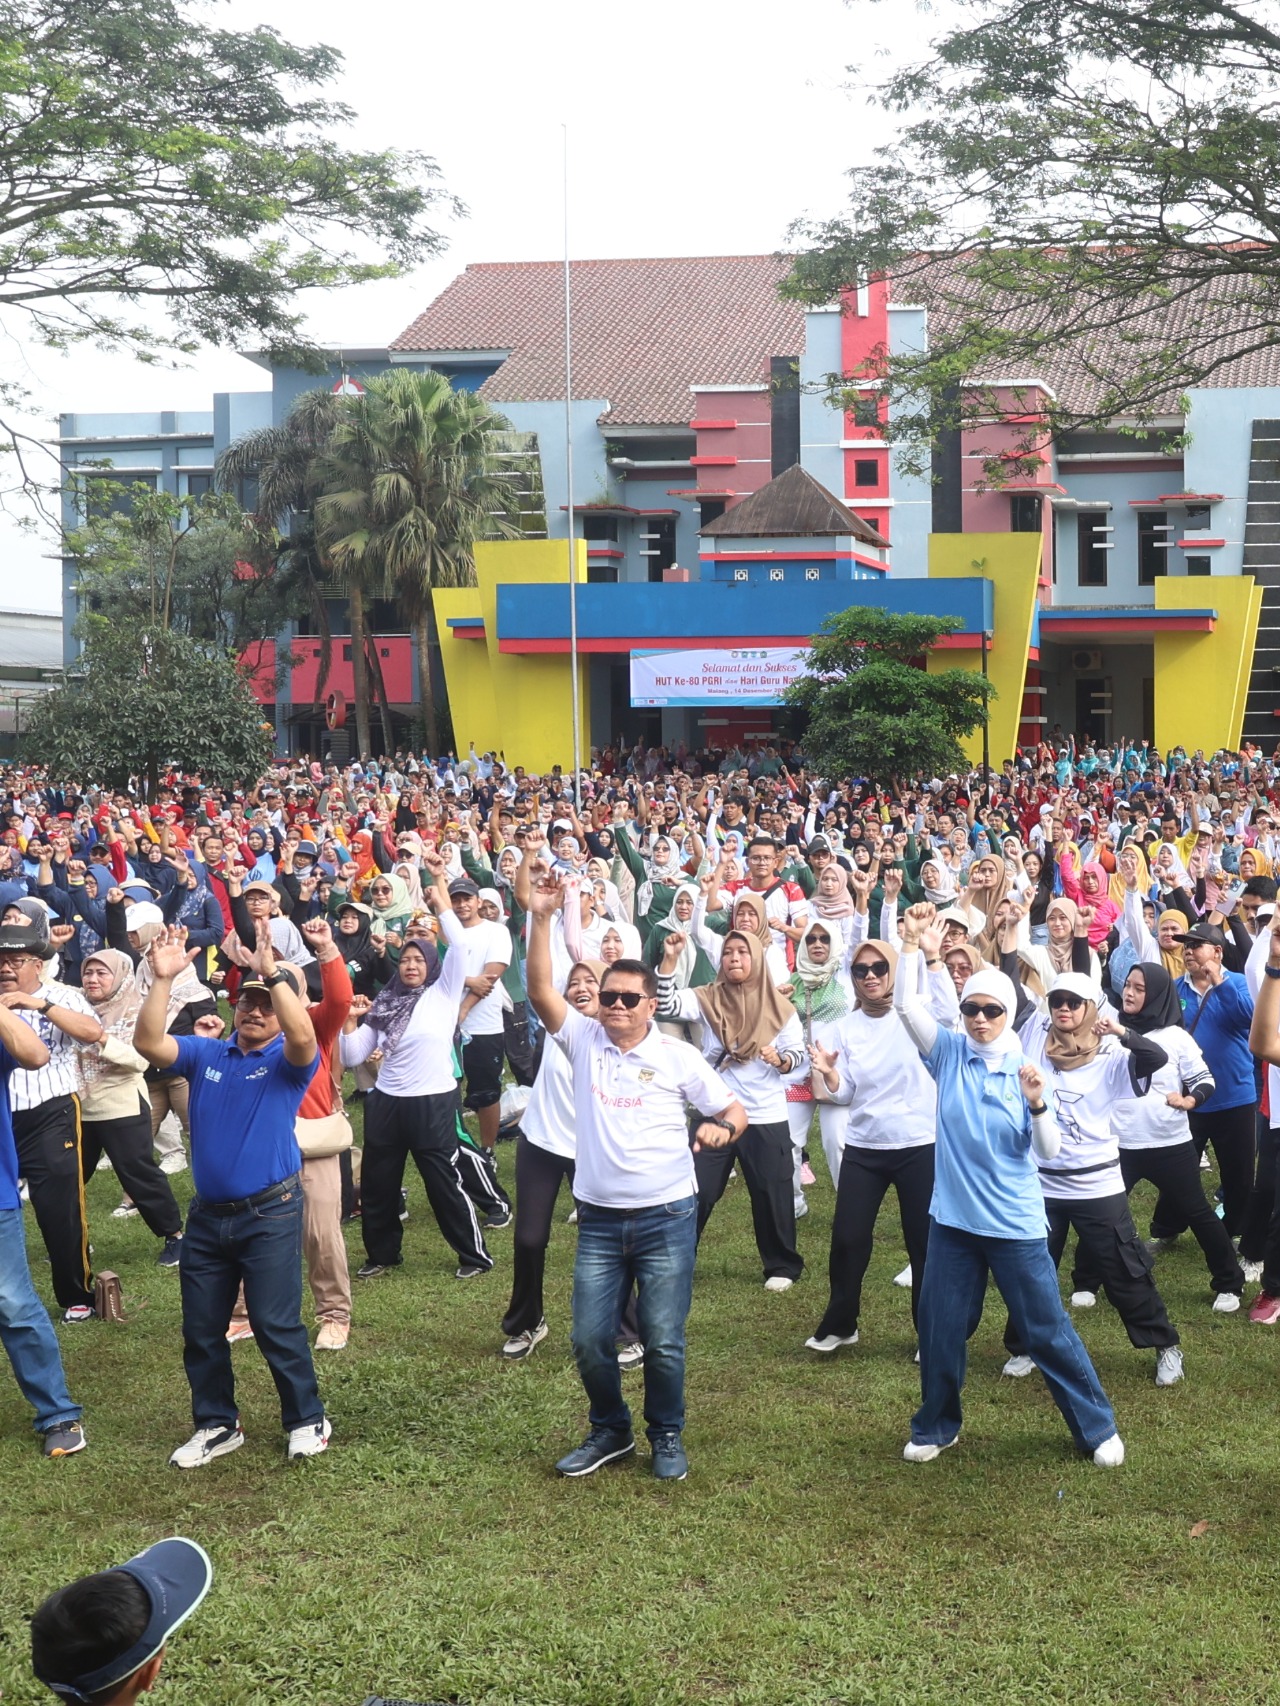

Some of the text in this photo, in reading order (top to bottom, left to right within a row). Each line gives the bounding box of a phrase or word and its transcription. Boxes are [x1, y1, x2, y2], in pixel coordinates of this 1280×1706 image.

[702, 662, 797, 673] Selamat dan Sukses
[655, 676, 672, 686] HUT
[674, 676, 699, 686] Ke-80
[702, 676, 722, 685] PGRI
[740, 675, 758, 685] Hari
[760, 675, 780, 685] Guru
[591, 1083, 643, 1108] IONESIA
